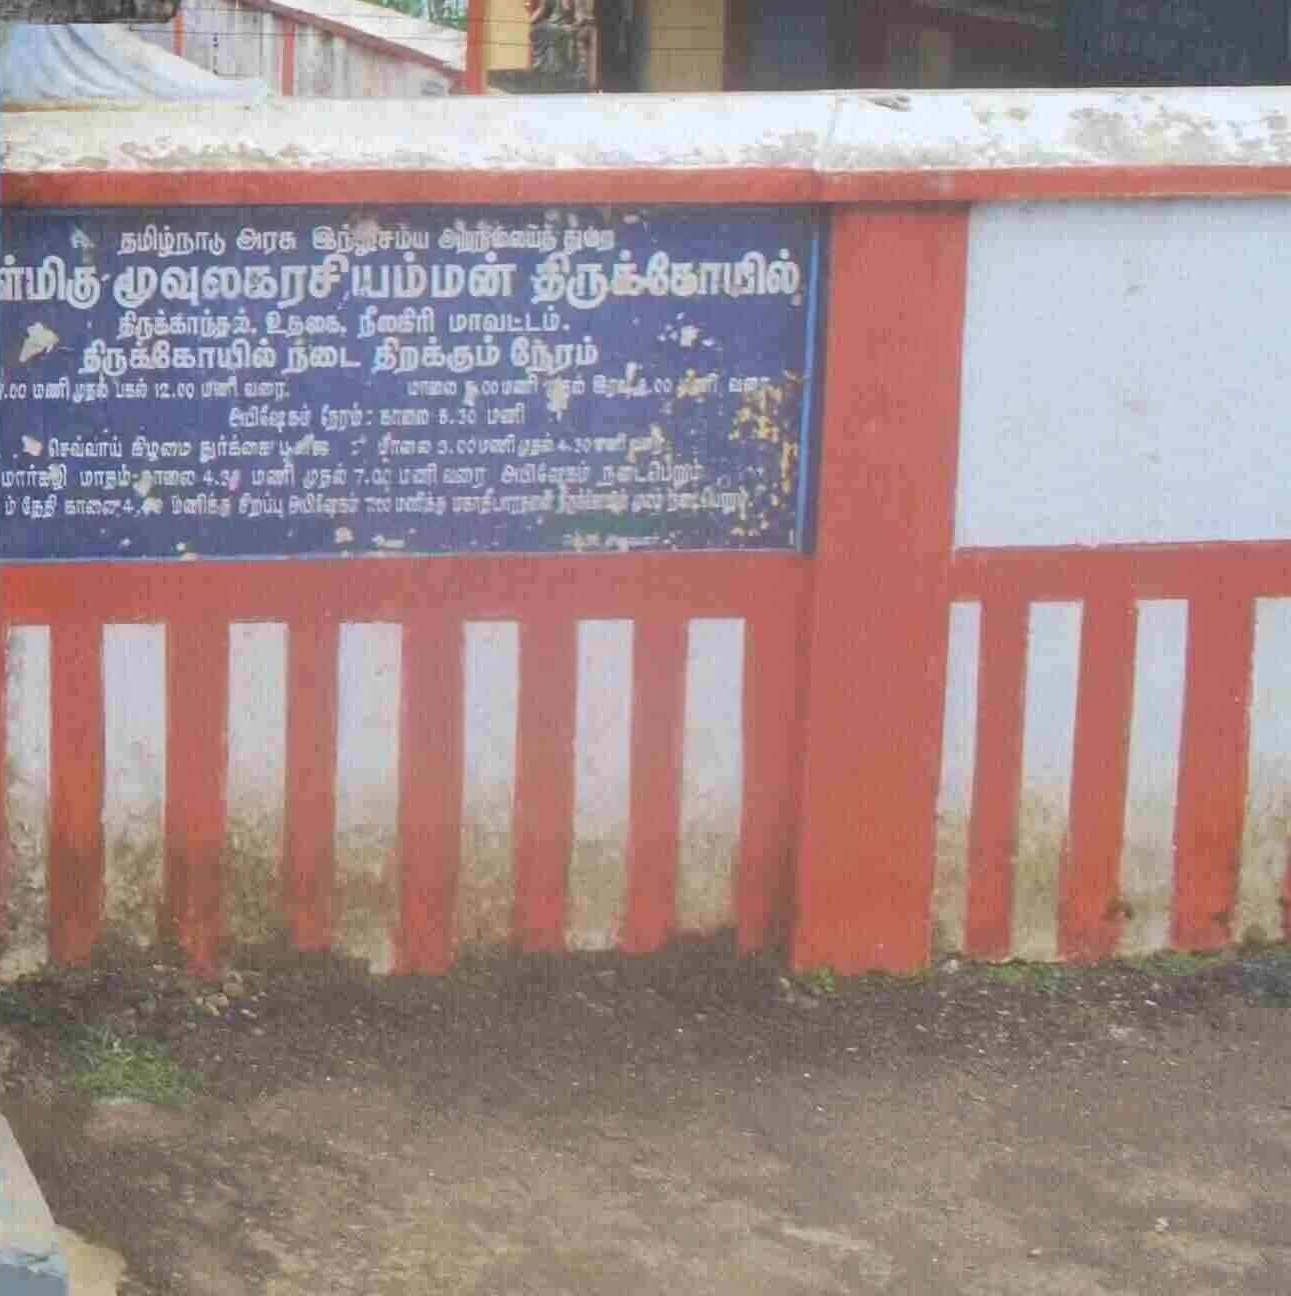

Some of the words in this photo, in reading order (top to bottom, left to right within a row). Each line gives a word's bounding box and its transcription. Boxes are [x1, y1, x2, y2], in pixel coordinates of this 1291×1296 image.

[117, 225, 226, 256] தமிழ்நாடு
[236, 227, 297, 253] அரசு
[530, 249, 802, 310] திருக்கோயில்
[357, 306, 436, 339] நீலகிரி
[449, 305, 571, 333] மாவட்டம்.
[78, 336, 277, 375] திருக்கோயில்
[282, 340, 362, 373] நடை
[370, 335, 501, 374] திறக்கும்
[510, 334, 600, 373] நேரம்
[32, 377, 69, 399] மணி
[487, 402, 526, 426] மணி
[48, 435, 123, 458] செவ்வாய்
[131, 435, 193, 463] கிழமை
[251, 463, 295, 487] மணி
[302, 463, 348, 489] முதல்
